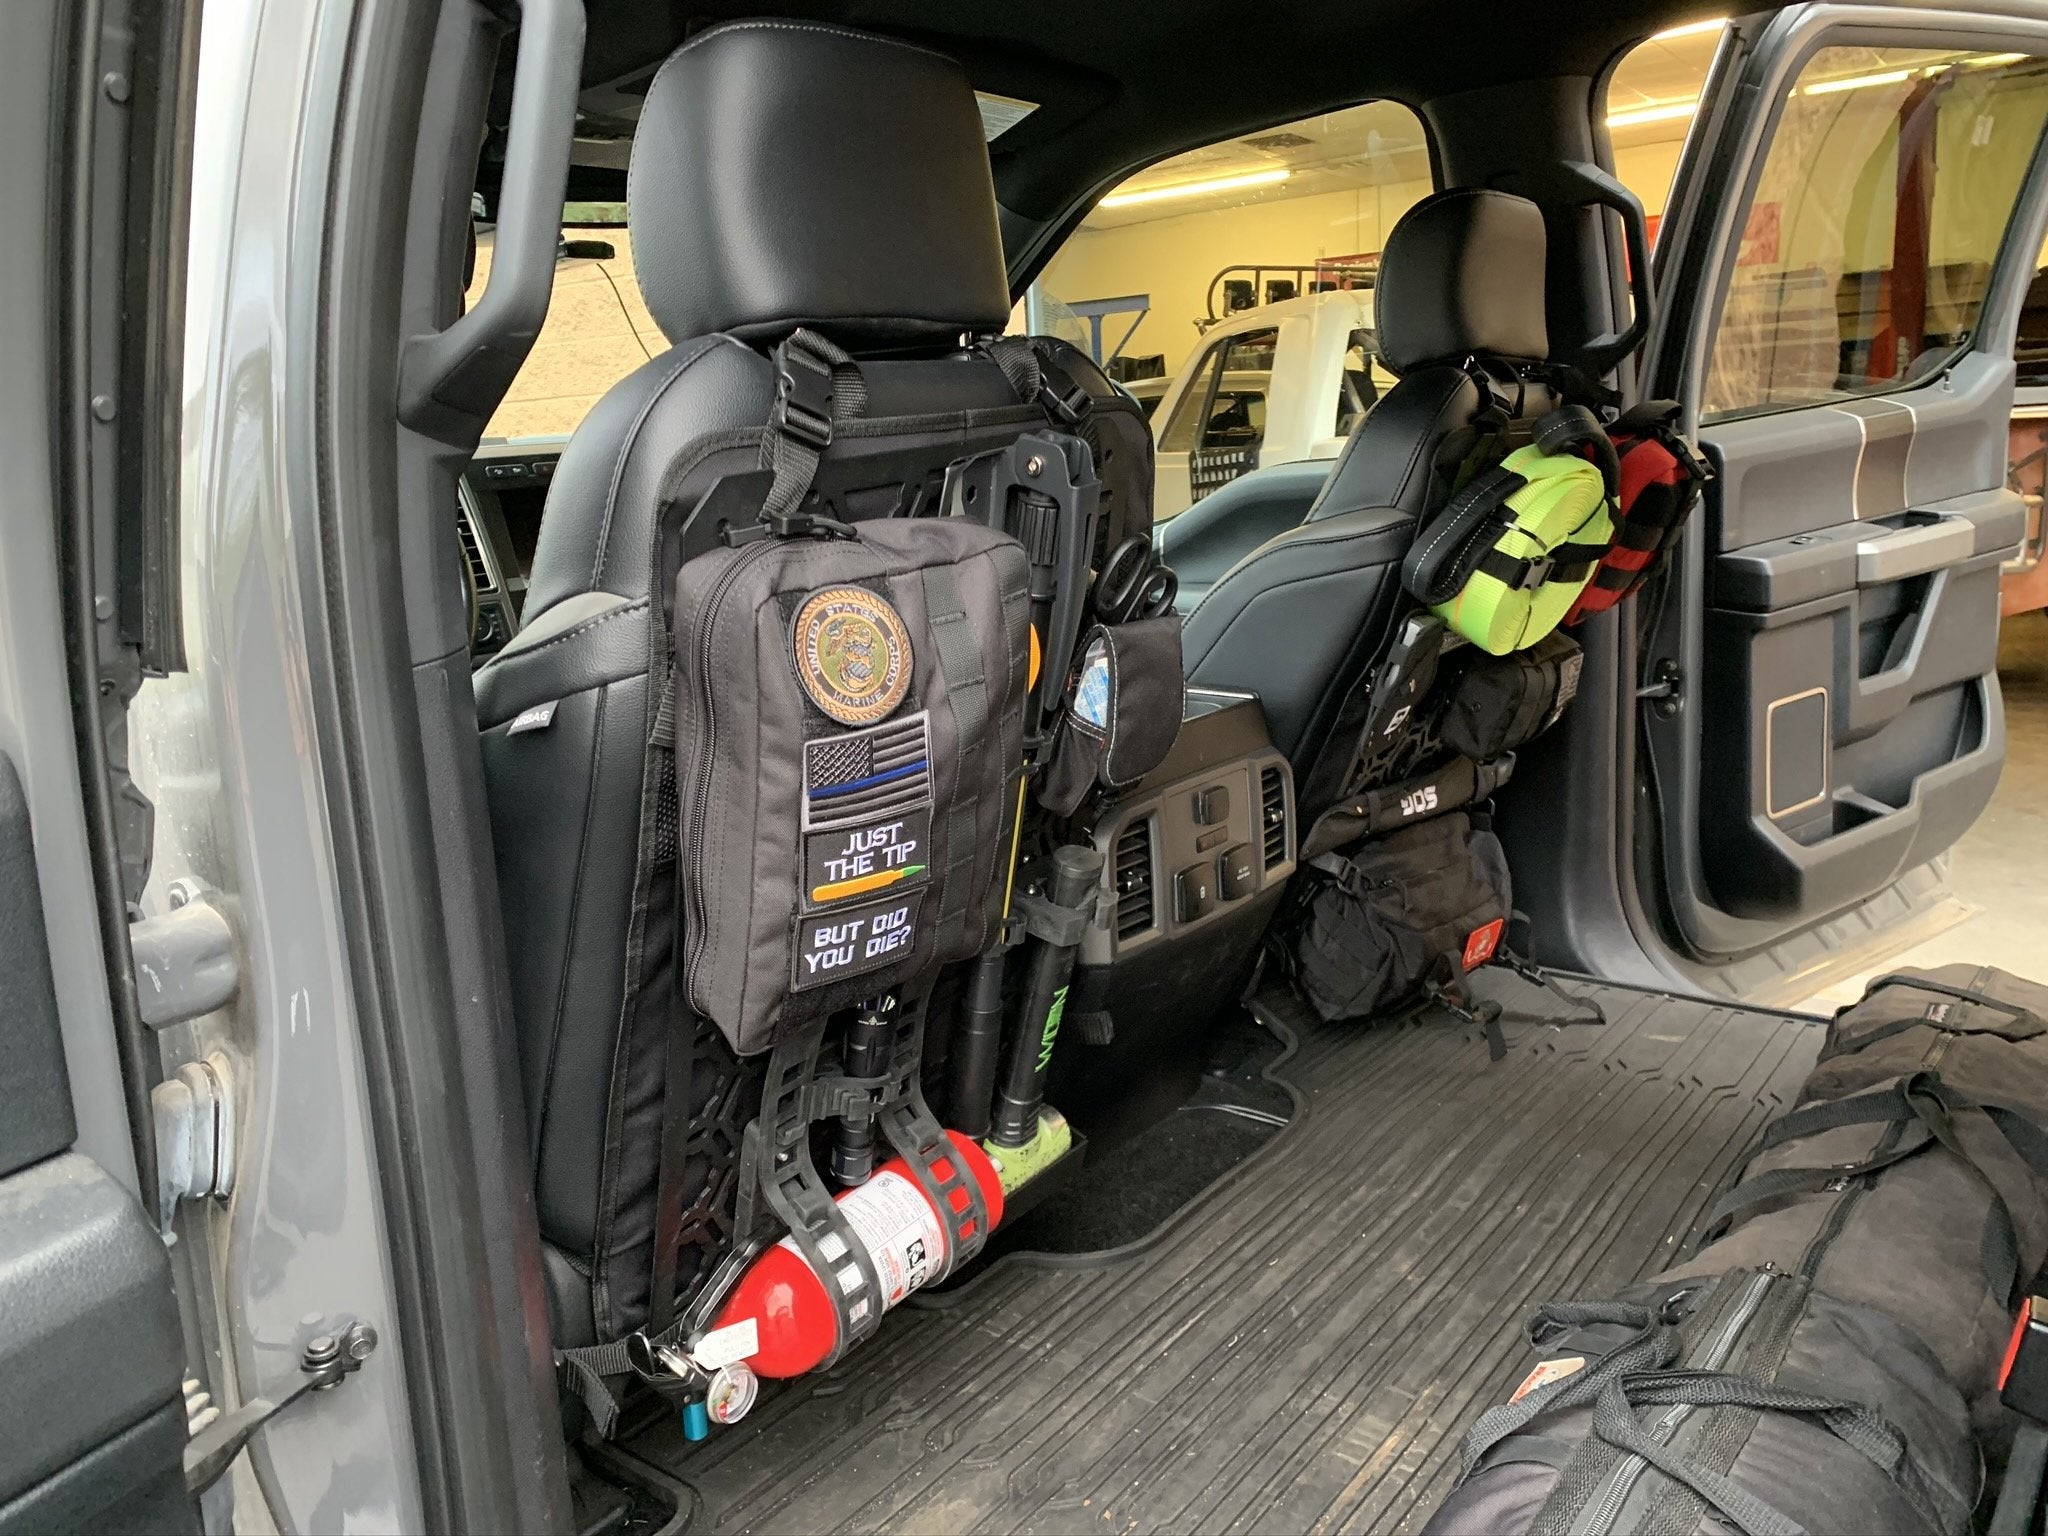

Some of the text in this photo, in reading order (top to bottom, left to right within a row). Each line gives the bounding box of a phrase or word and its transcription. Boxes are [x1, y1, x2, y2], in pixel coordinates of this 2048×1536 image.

[807, 603, 879, 676] UNITED STATES
[833, 636, 900, 707] MARINE CORPS
[824, 839, 917, 882] THE TIP
[841, 822, 904, 856] JUST
[804, 925, 912, 974] YOU DIE?
[814, 906, 909, 949] BUT DID
